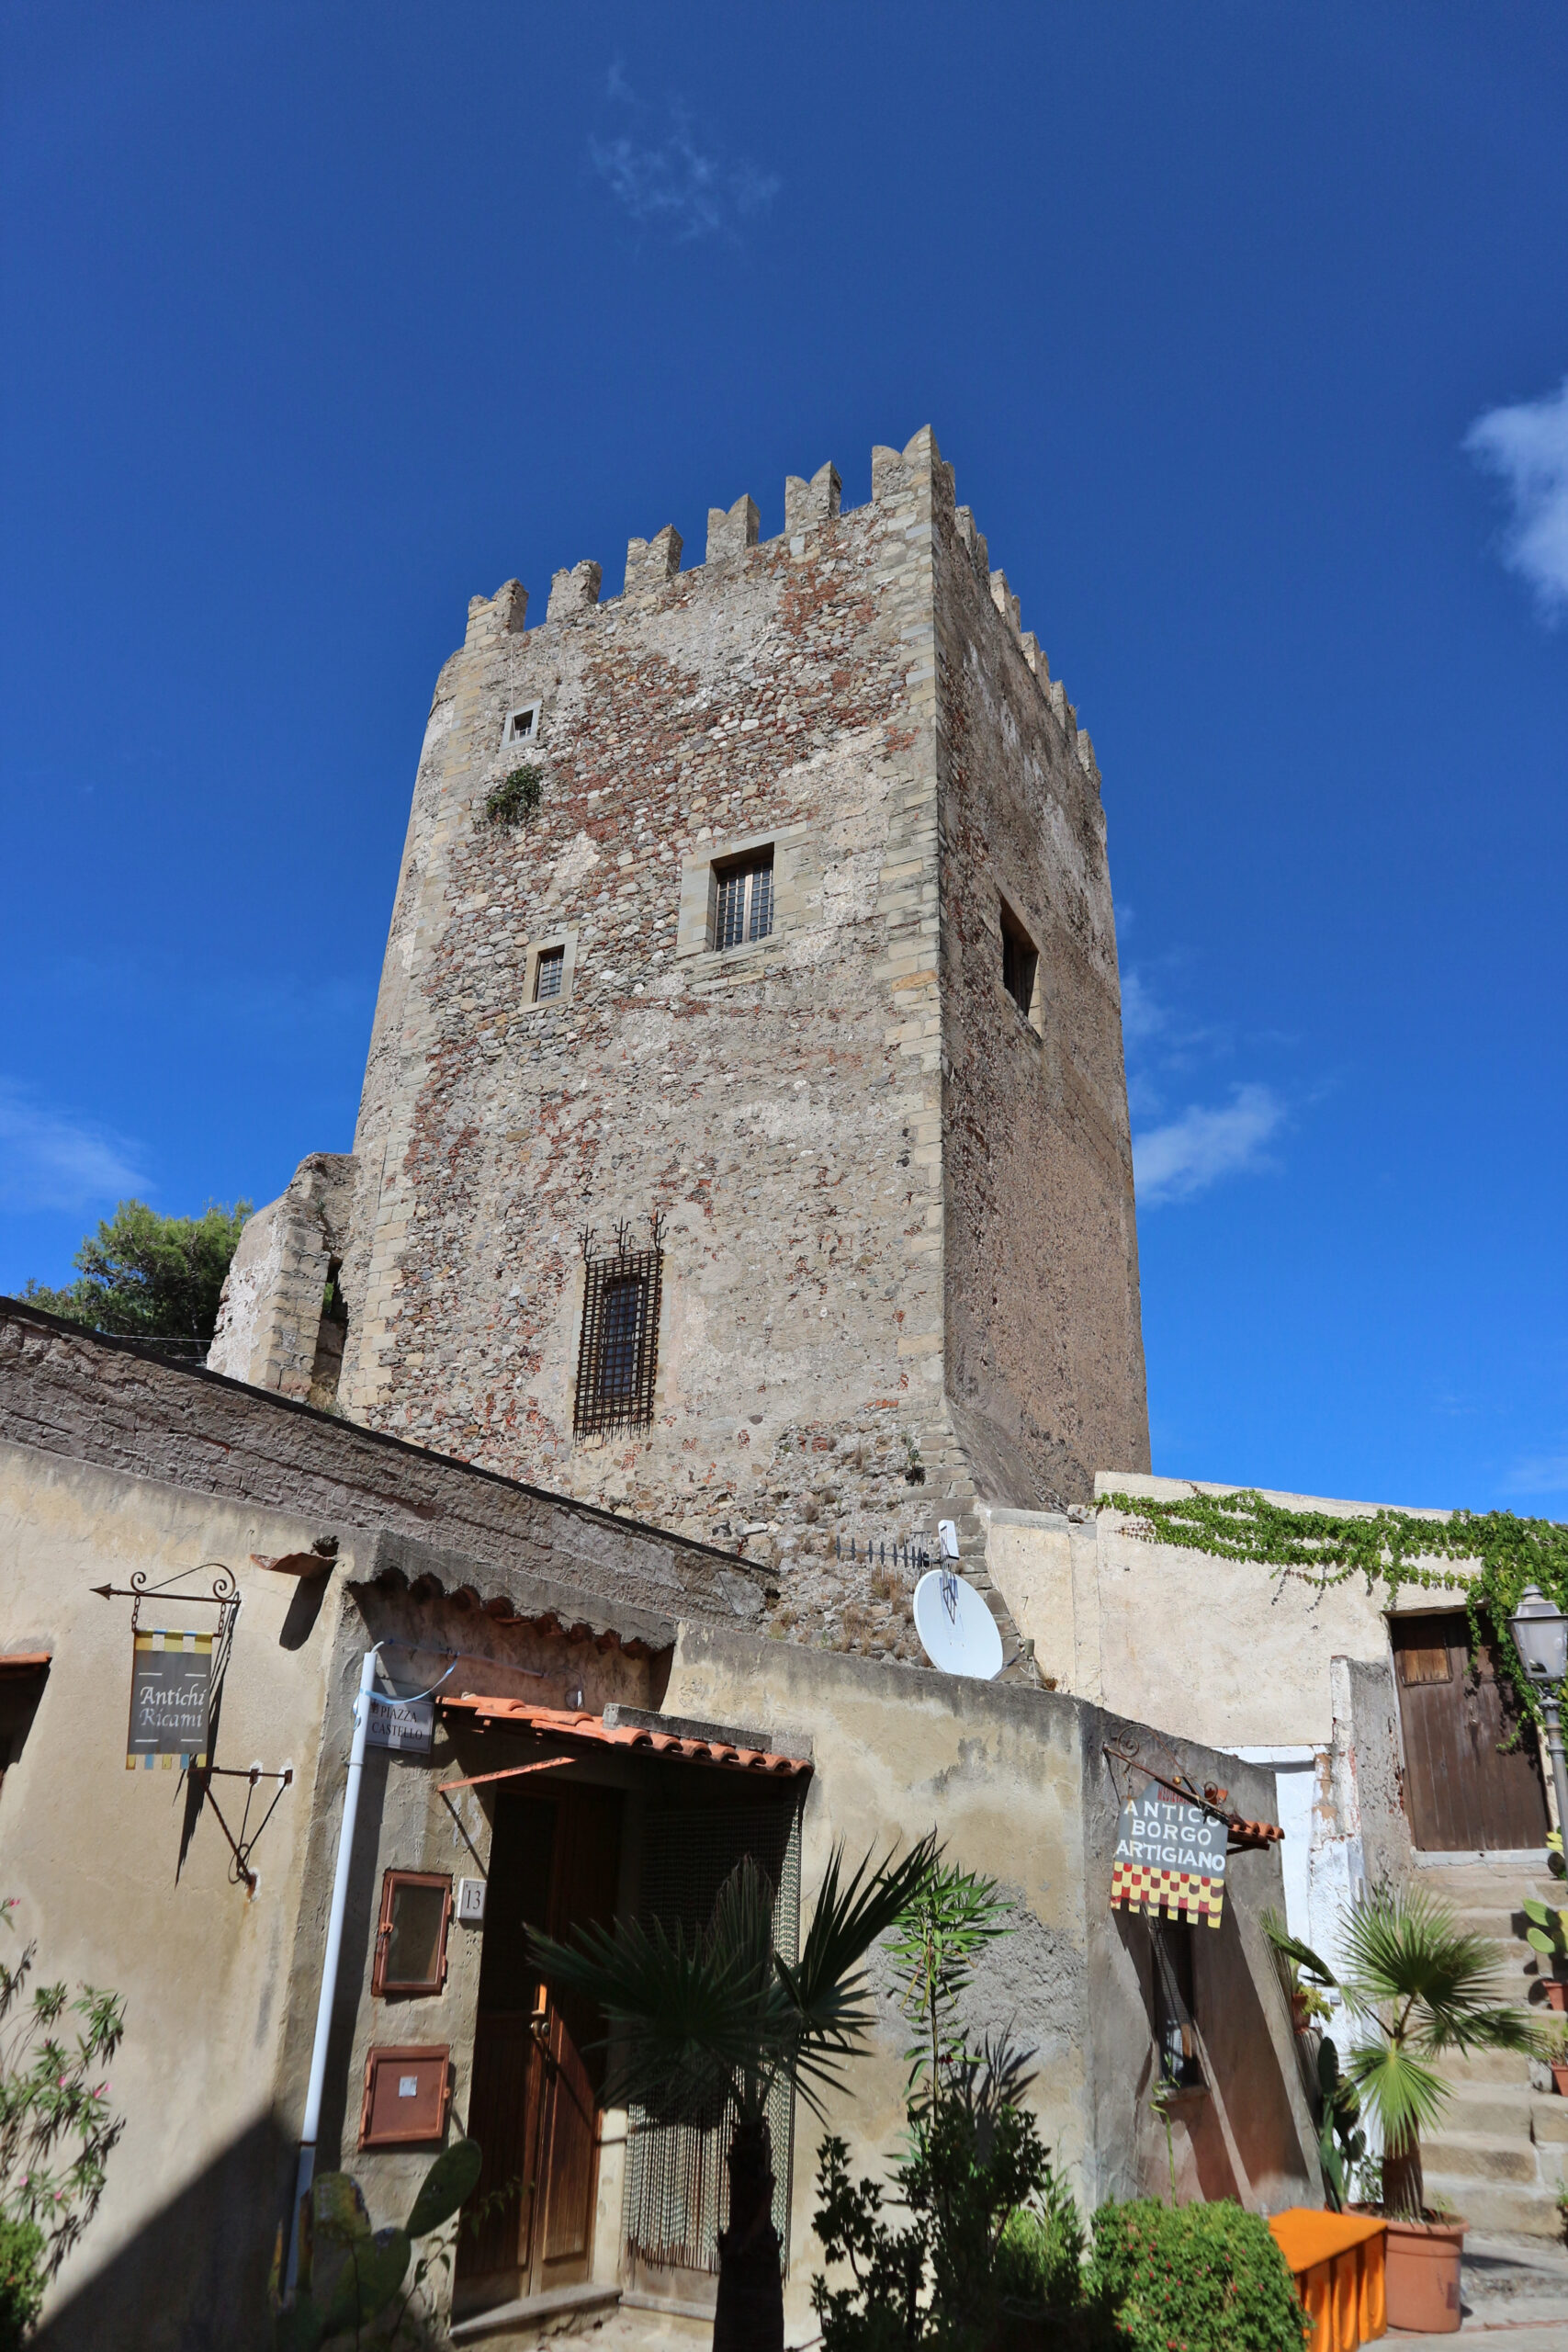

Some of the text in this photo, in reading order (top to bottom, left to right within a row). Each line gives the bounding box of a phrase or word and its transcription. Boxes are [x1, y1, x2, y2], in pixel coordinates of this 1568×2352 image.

[140, 1683, 208, 1706] Antichi
[139, 1707, 204, 1727] Ricami
[380, 1705, 417, 1723] PIAZZA
[371, 1721, 423, 1740] CASTELLO
[1132, 1818, 1212, 1846] BORGO
[1116, 1839, 1226, 1871] ARTIGIANO
[466, 1889, 481, 1910] 13
